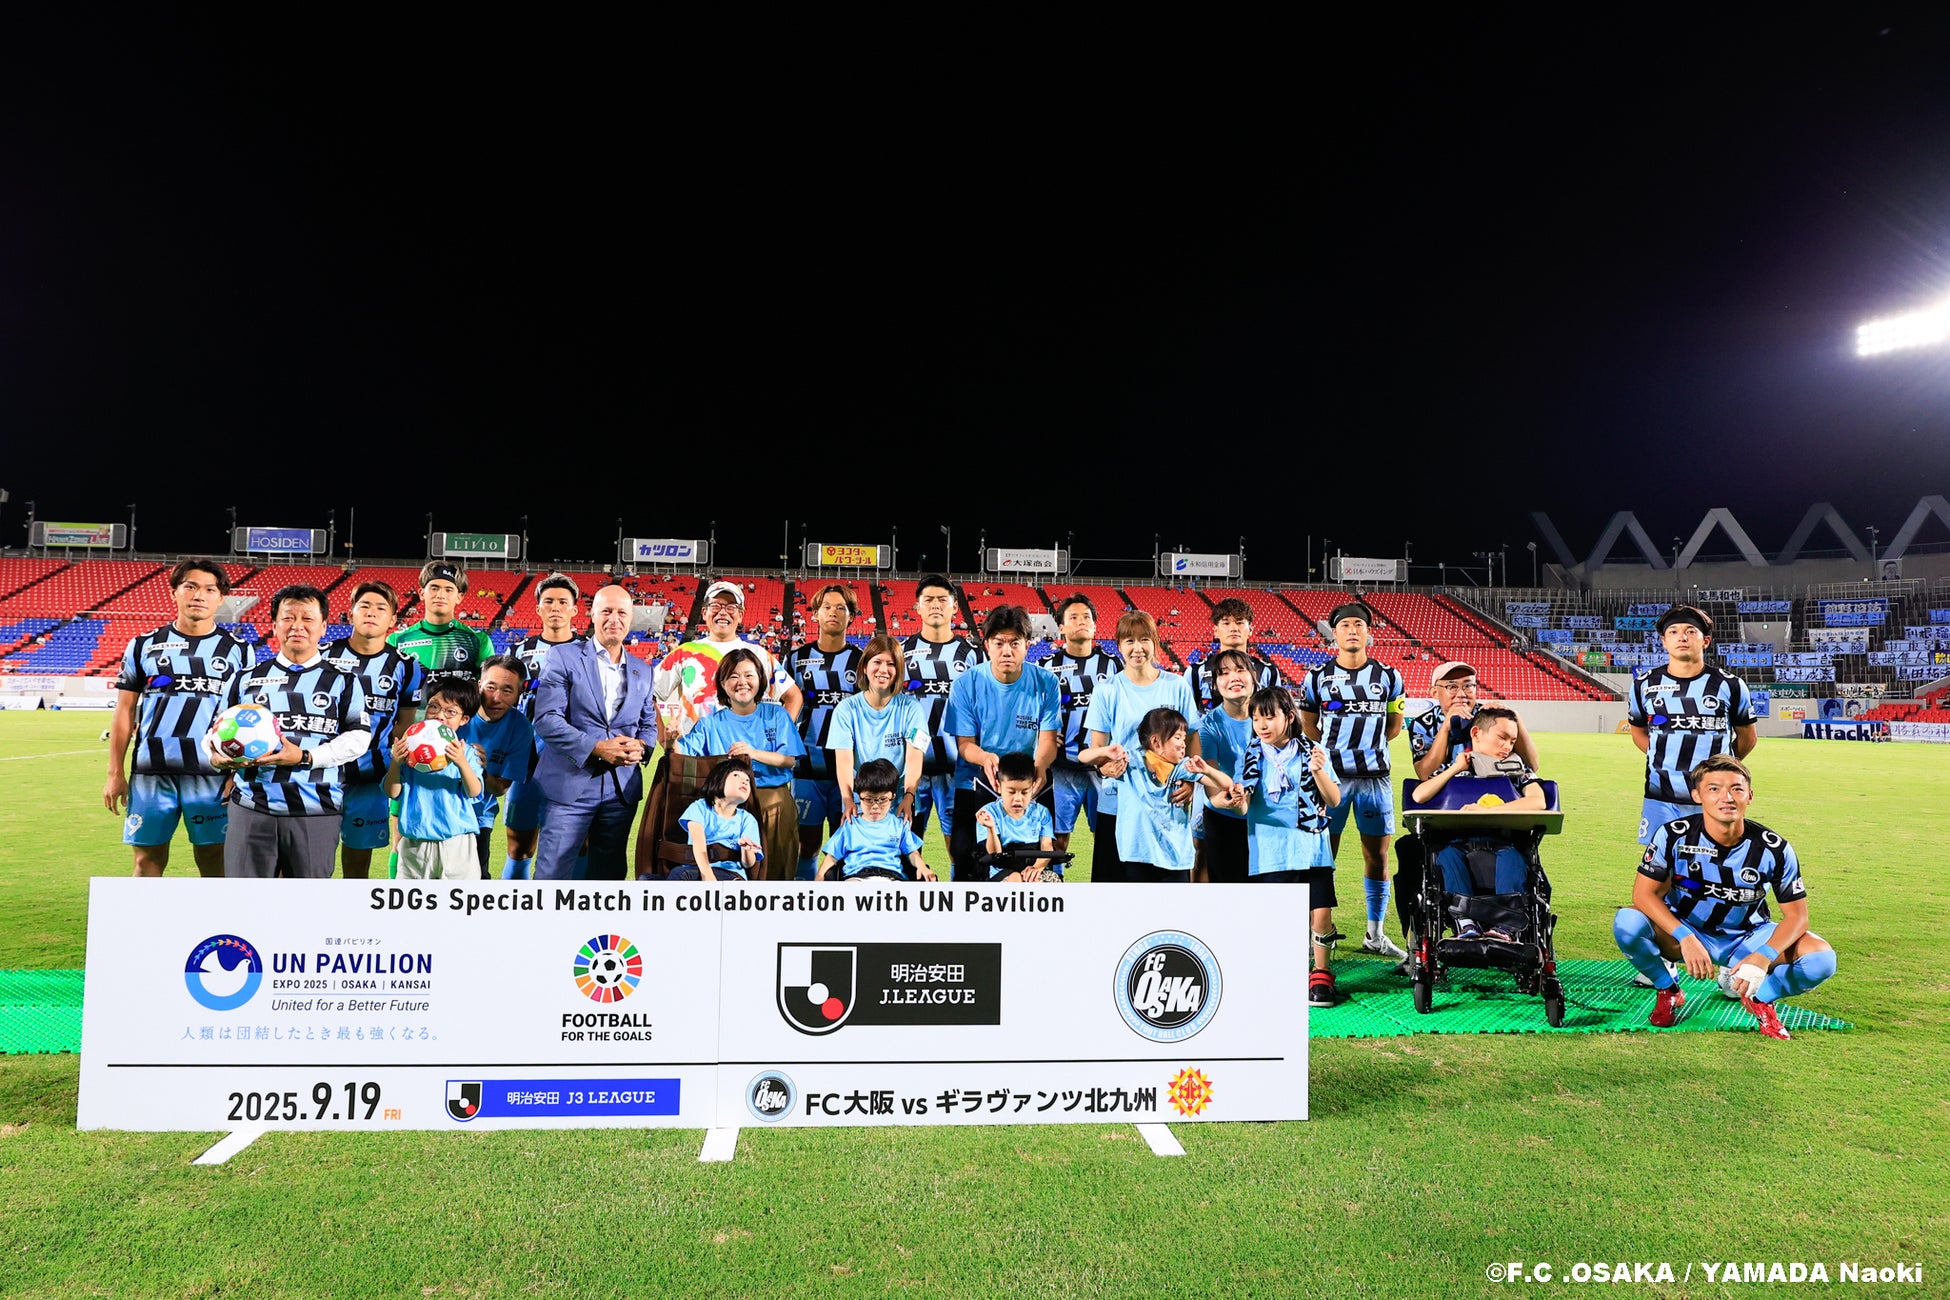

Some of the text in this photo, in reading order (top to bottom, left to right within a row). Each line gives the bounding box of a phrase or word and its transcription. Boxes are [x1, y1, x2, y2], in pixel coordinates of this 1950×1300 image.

[251, 537, 310, 549] HOSIDEN
[454, 537, 498, 550] LIVIO
[639, 544, 692, 557] カツロン
[817, 690, 852, 704] 大末
[127, 813, 143, 836] 9
[370, 887, 1064, 916] SDGs Special Match in collaboration with UN Pavilion
[325, 937, 382, 946] 国連パビリオン
[272, 953, 432, 974] UN PAVILION
[1143, 952, 1167, 972] FC
[891, 963, 965, 983] 明治安田
[273, 979, 431, 990] EXPO 2025 OSAKA KANSAI
[879, 989, 976, 1005] J.LEAGUE
[271, 999, 430, 1012] United for a Better Future
[562, 1013, 653, 1028] FOOTBALL
[181, 1025, 441, 1041] 人類は団結したとき最も強くなる。
[561, 1030, 653, 1042] FOR THE GOALS
[227, 1081, 402, 1121] 2025.9.19 FRI
[506, 1091, 656, 1106] 明治安田 J3 LEAGUE
[805, 1086, 1157, 1116] FC大阪 vs ギラヴァンツ北九州
